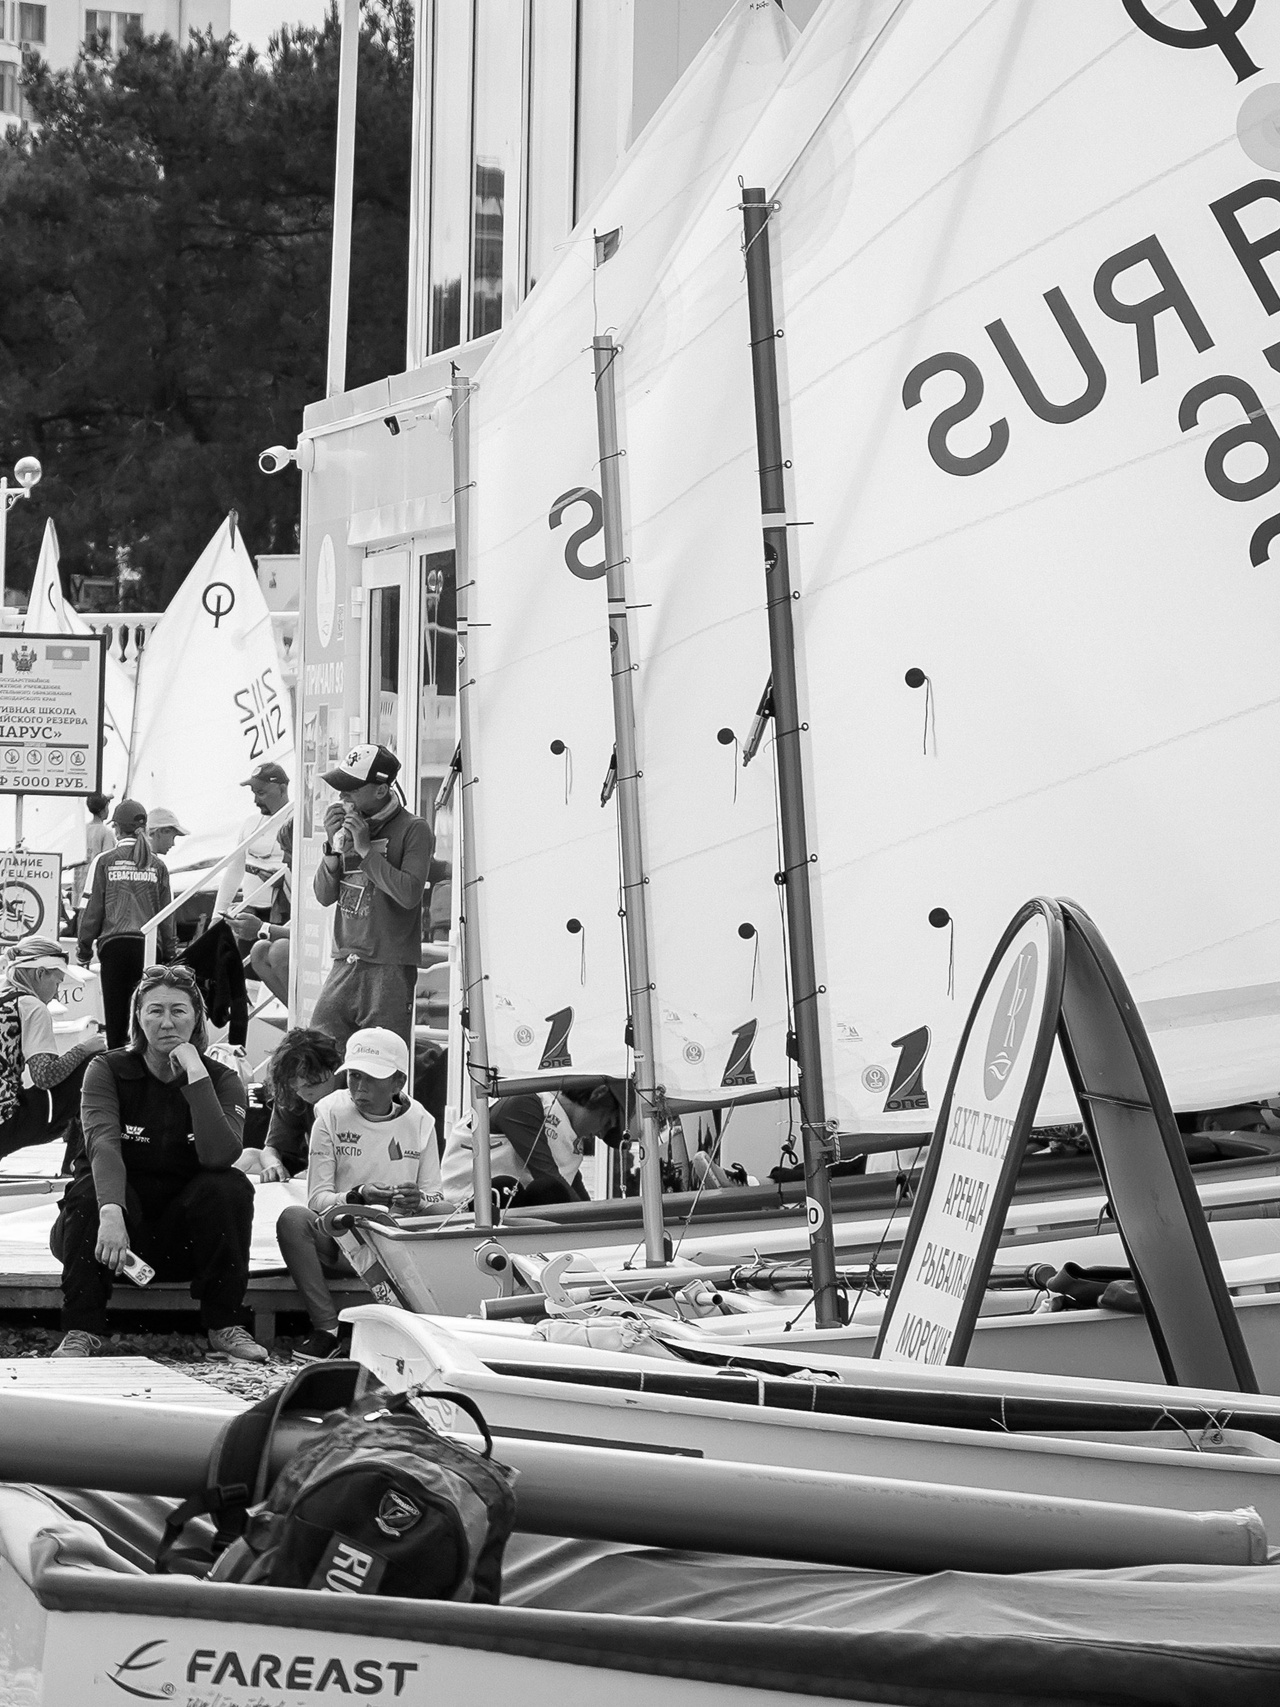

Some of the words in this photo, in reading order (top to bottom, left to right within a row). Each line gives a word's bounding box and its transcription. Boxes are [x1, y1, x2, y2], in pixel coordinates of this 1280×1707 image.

[38, 706, 76, 716] ШКОЛА
[46, 716, 89, 726] РЕЗЕРВА
[244, 704, 286, 760] 2112
[12, 775, 50, 787] 5000
[55, 777, 88, 789] РУБ.
[108, 870, 158, 883] СЕВАСТОПОЛЬ
[949, 1106, 980, 1150] ЯХТ
[942, 1173, 990, 1233] АРЕНДА
[186, 1648, 419, 1697] FAREAST
